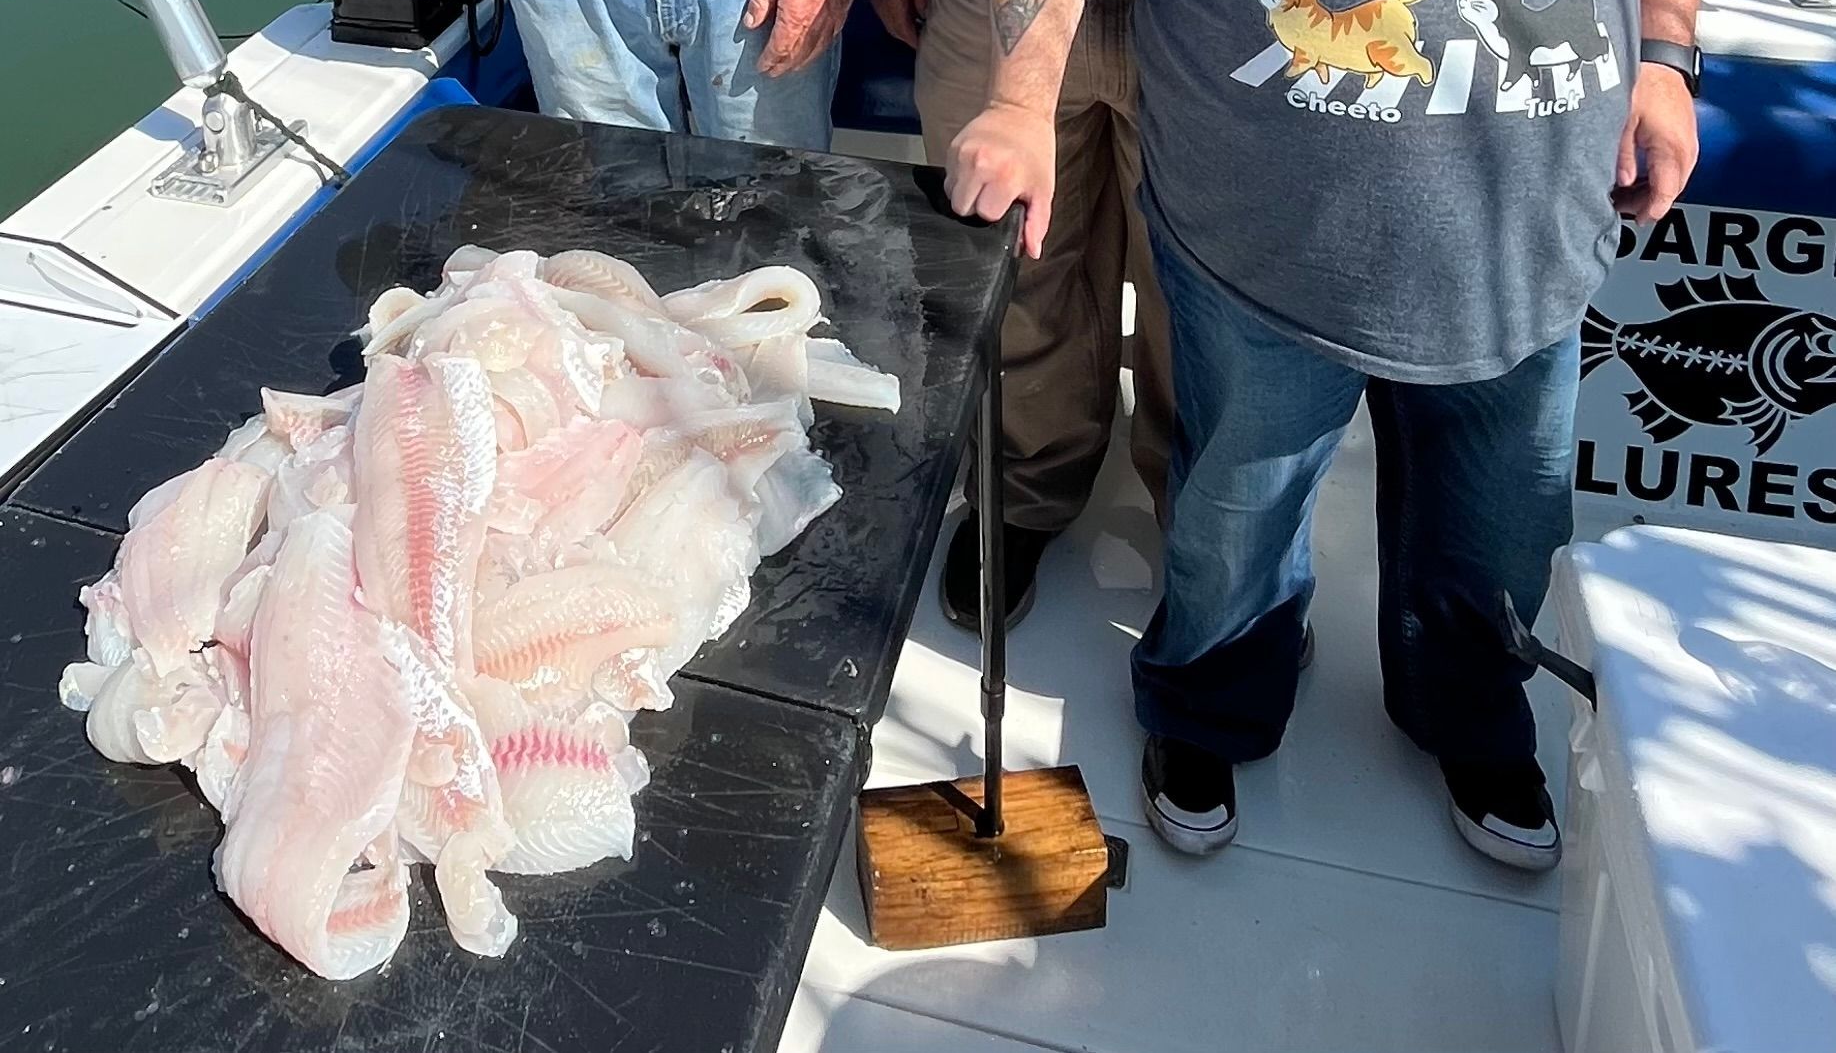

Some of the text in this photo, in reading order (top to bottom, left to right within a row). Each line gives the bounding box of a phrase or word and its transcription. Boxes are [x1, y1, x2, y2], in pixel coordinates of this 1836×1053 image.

[1285, 88, 1402, 124] Cheeto
[1525, 92, 1584, 120] Tuck
[1615, 207, 1836, 278] ARG
[1574, 439, 1836, 525] LURES
